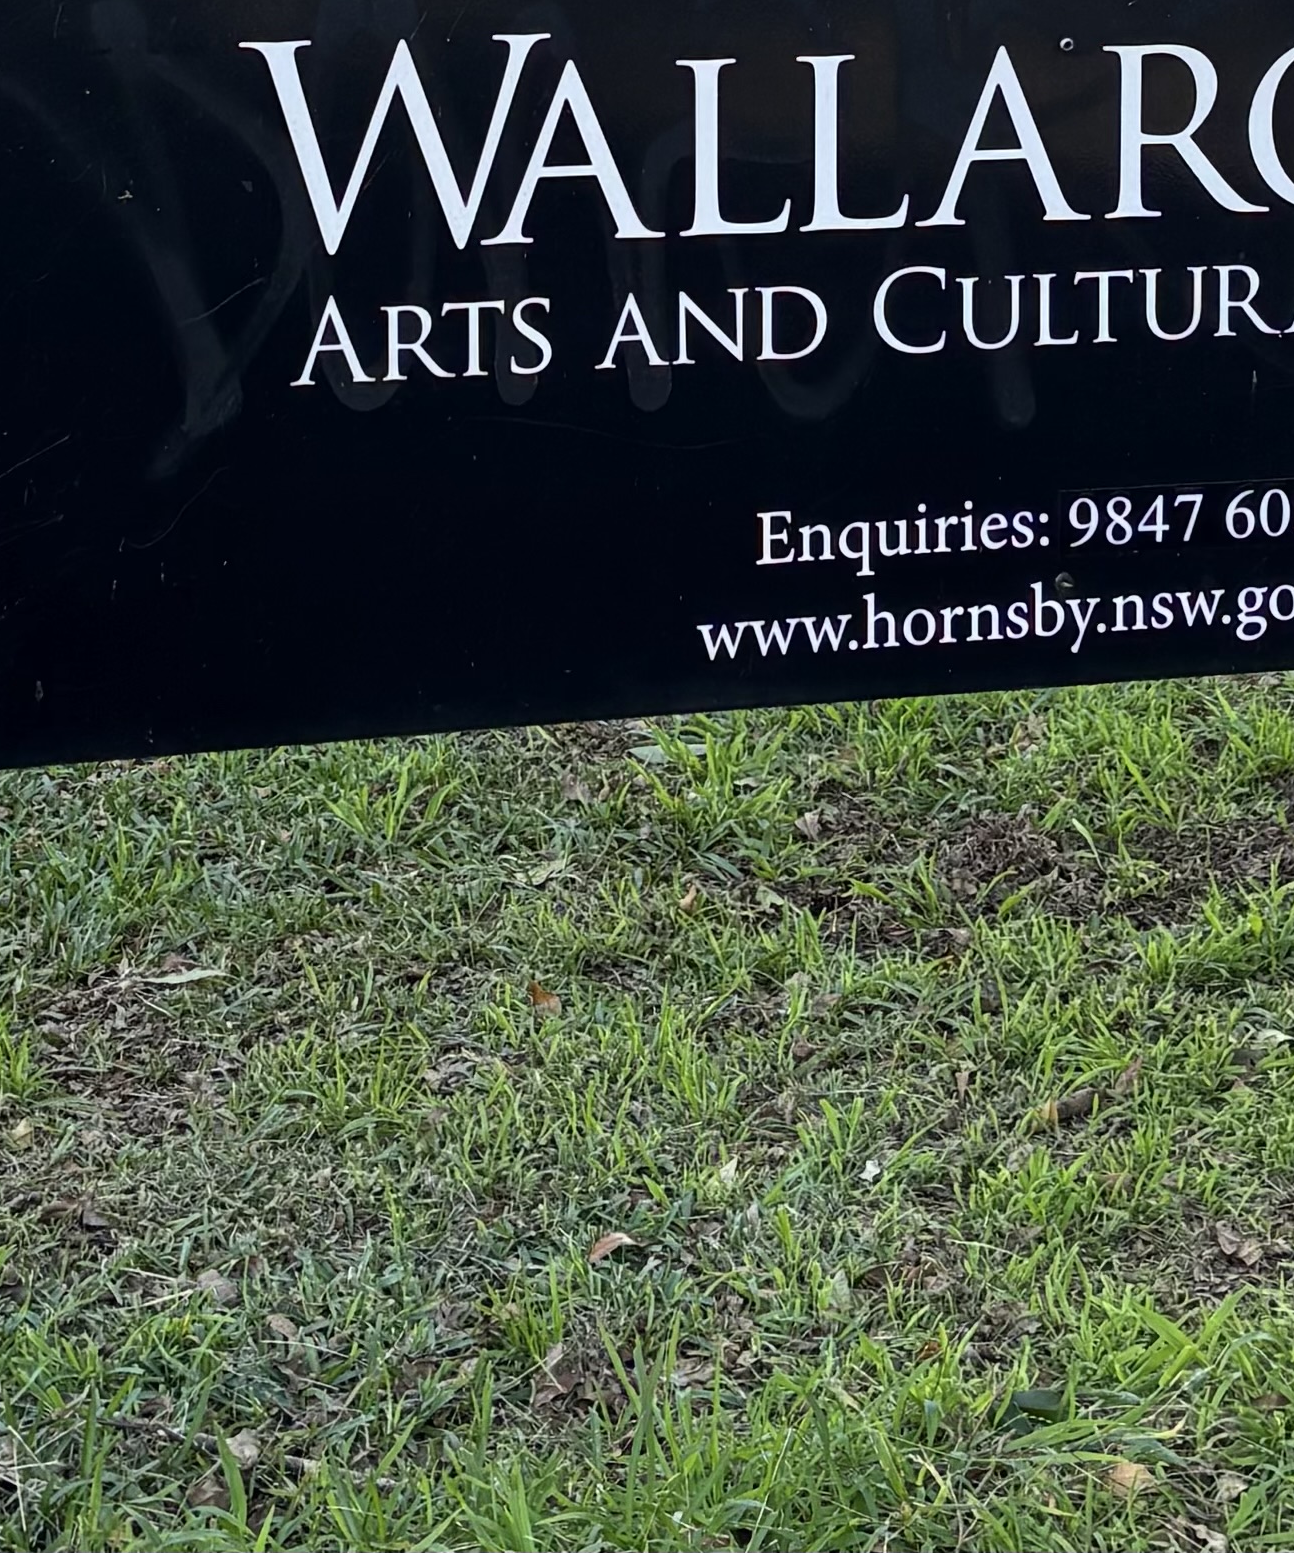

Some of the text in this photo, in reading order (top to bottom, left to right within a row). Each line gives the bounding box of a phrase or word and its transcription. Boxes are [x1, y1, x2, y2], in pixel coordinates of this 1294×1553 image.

[290, 295, 553, 387] ARTS
[594, 285, 828, 370] AND
[755, 500, 1050, 577] Enquiries:
[1068, 493, 1204, 548] 9847
